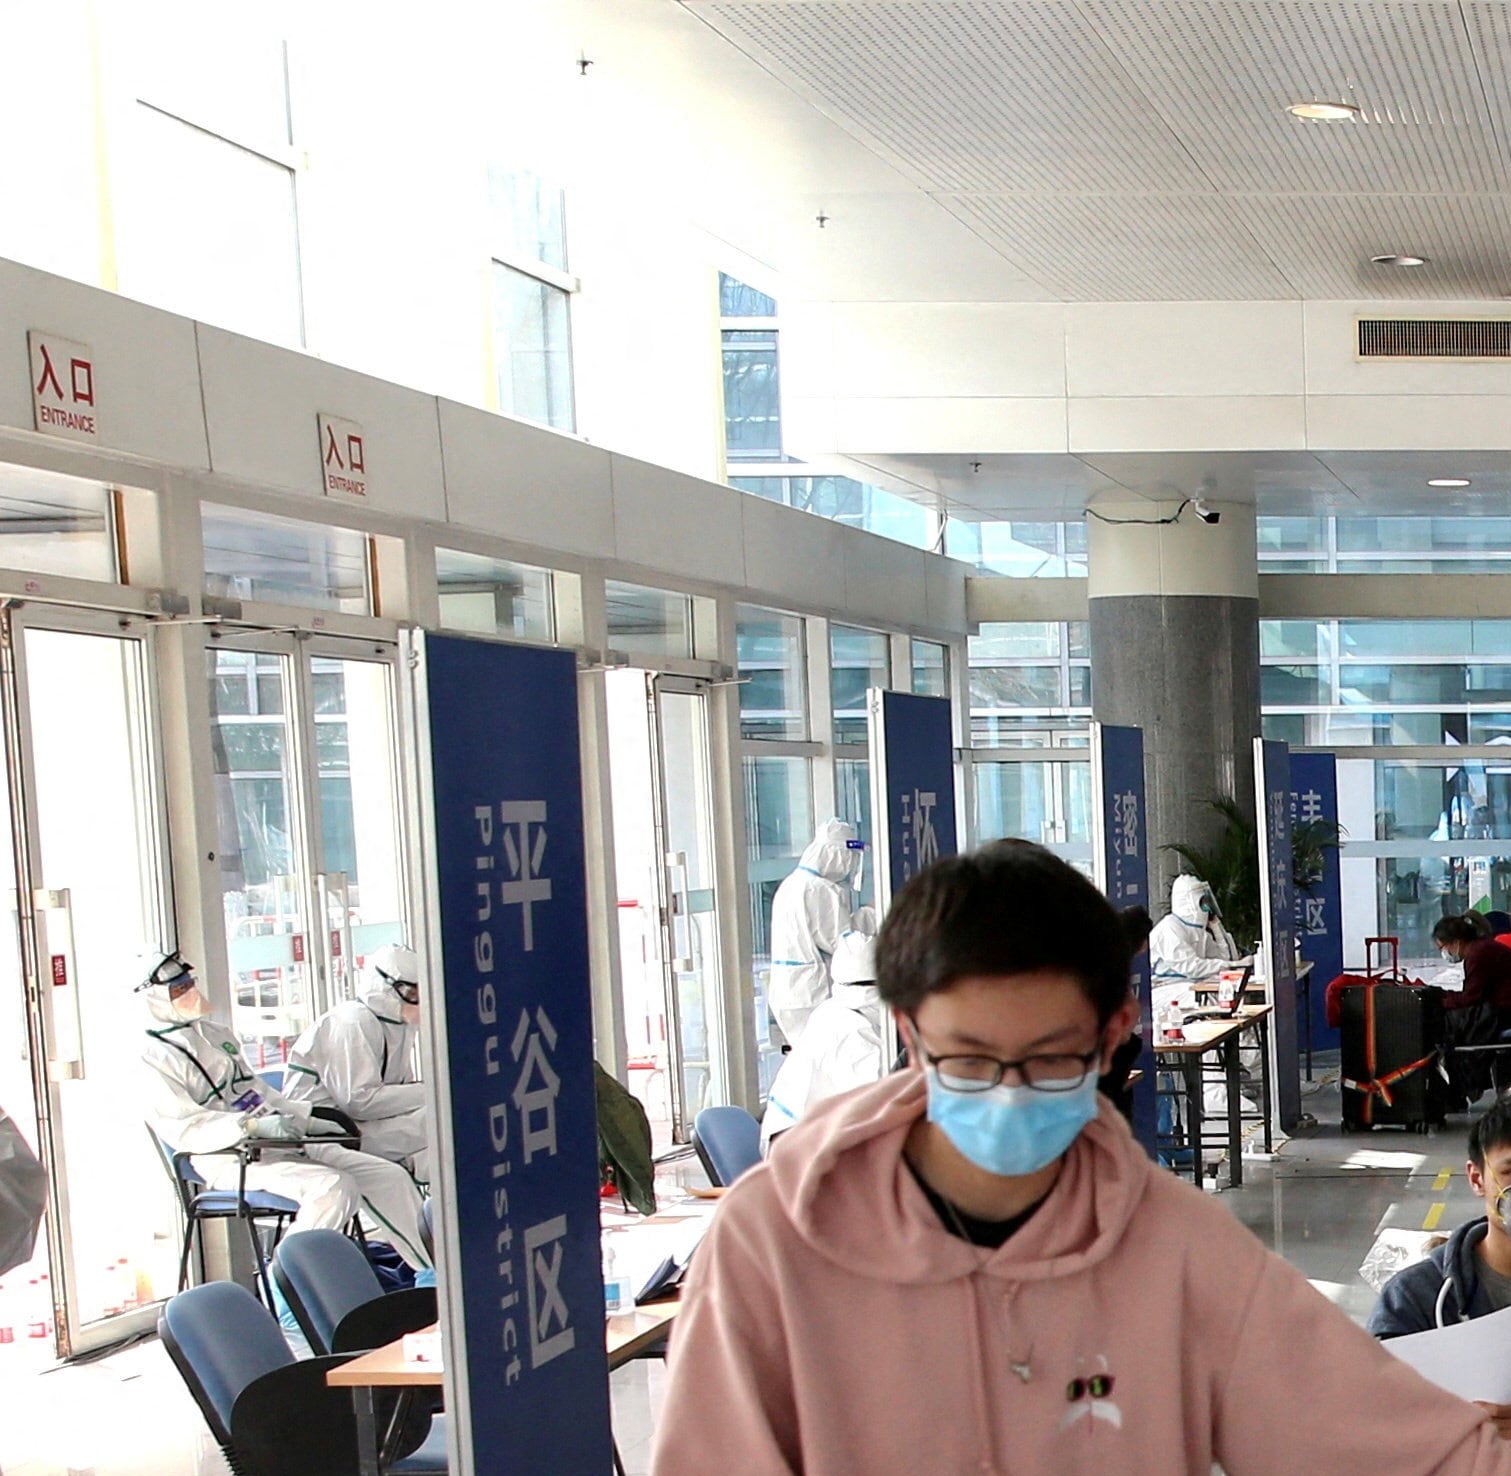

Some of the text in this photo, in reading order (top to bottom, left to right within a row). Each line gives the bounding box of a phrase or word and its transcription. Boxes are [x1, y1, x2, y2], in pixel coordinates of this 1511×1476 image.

[37, 344, 95, 407] 入口
[40, 404, 96, 435] ENTRANCE
[325, 423, 366, 475] 入口
[328, 474, 367, 497] ENTRANCE
[472, 804, 523, 1387] Pinggu District
[501, 799, 576, 1370] 平谷区
